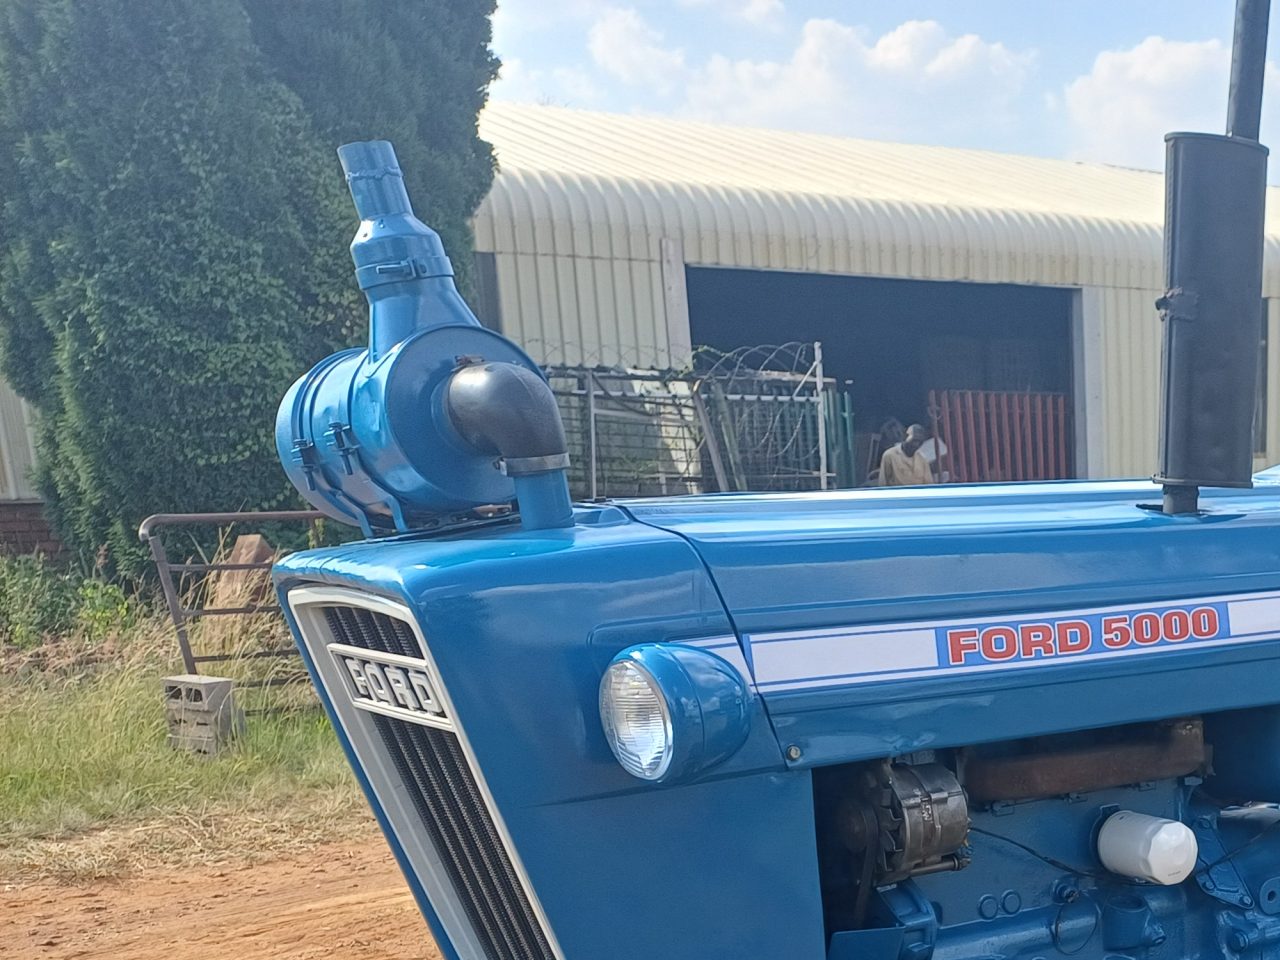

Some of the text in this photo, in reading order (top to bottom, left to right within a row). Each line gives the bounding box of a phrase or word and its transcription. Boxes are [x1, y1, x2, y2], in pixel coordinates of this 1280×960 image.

[947, 606, 1219, 666] FORD 5000
[344, 656, 443, 714] FORD
